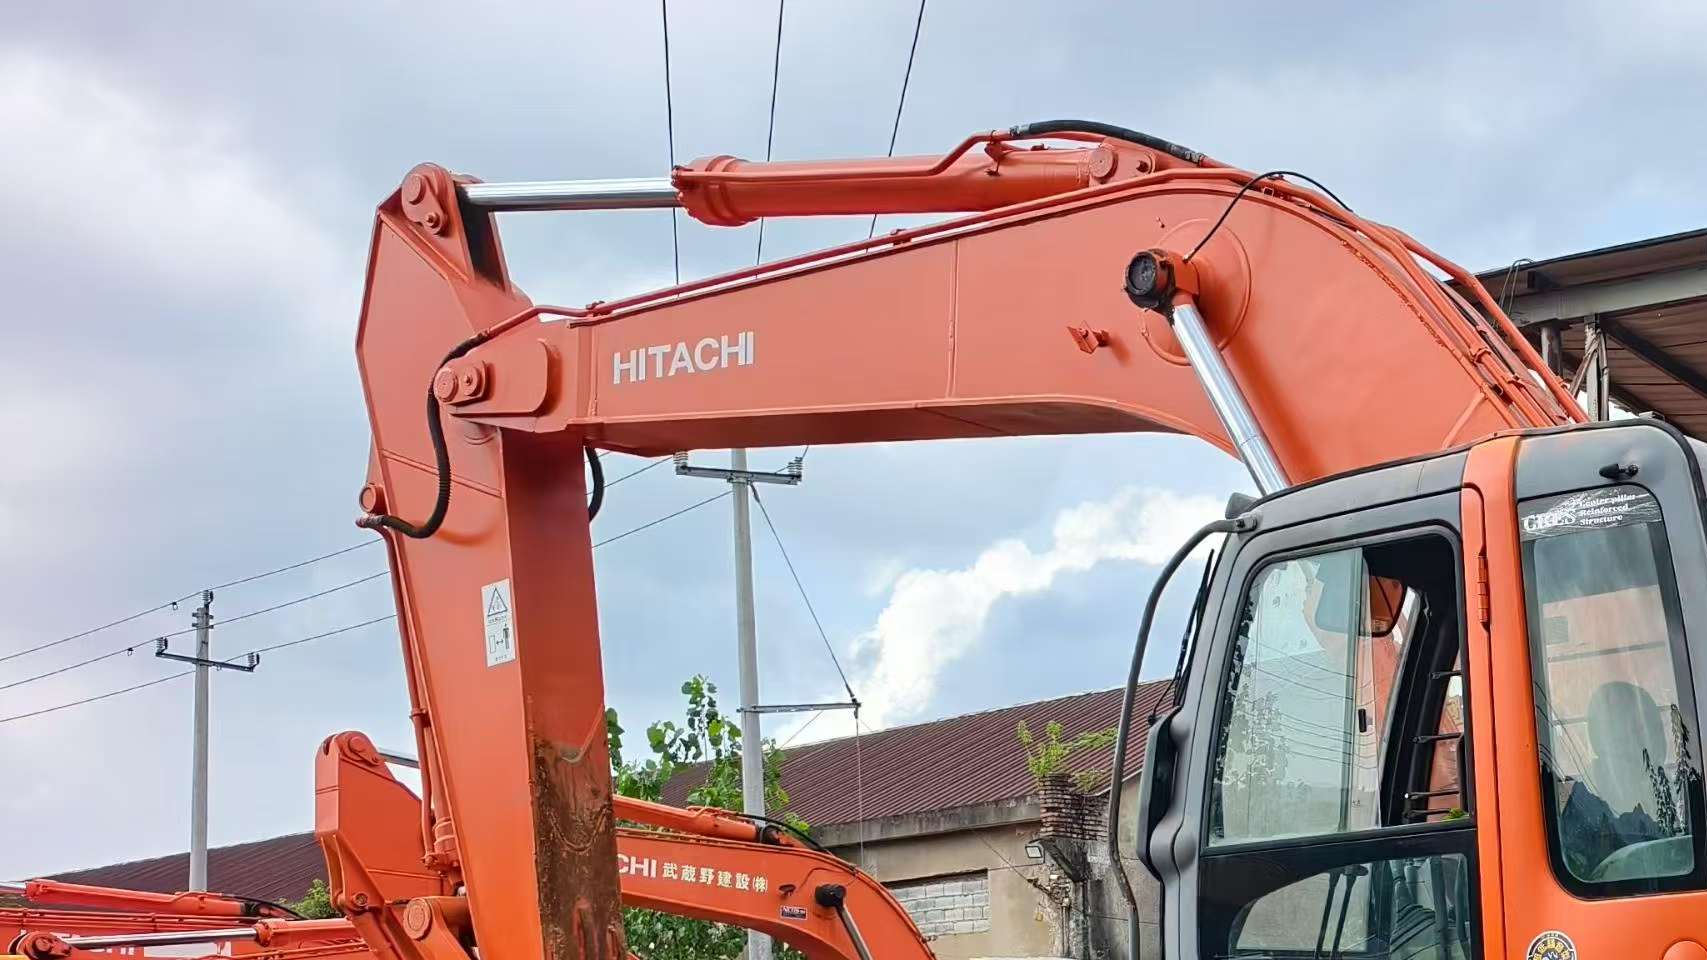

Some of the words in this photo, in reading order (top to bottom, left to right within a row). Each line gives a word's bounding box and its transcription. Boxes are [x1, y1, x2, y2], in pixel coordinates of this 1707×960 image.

[613, 331, 754, 384] HITACHI
[1581, 504, 1629, 516] Reinforced
[1580, 514, 1623, 526] Structure
